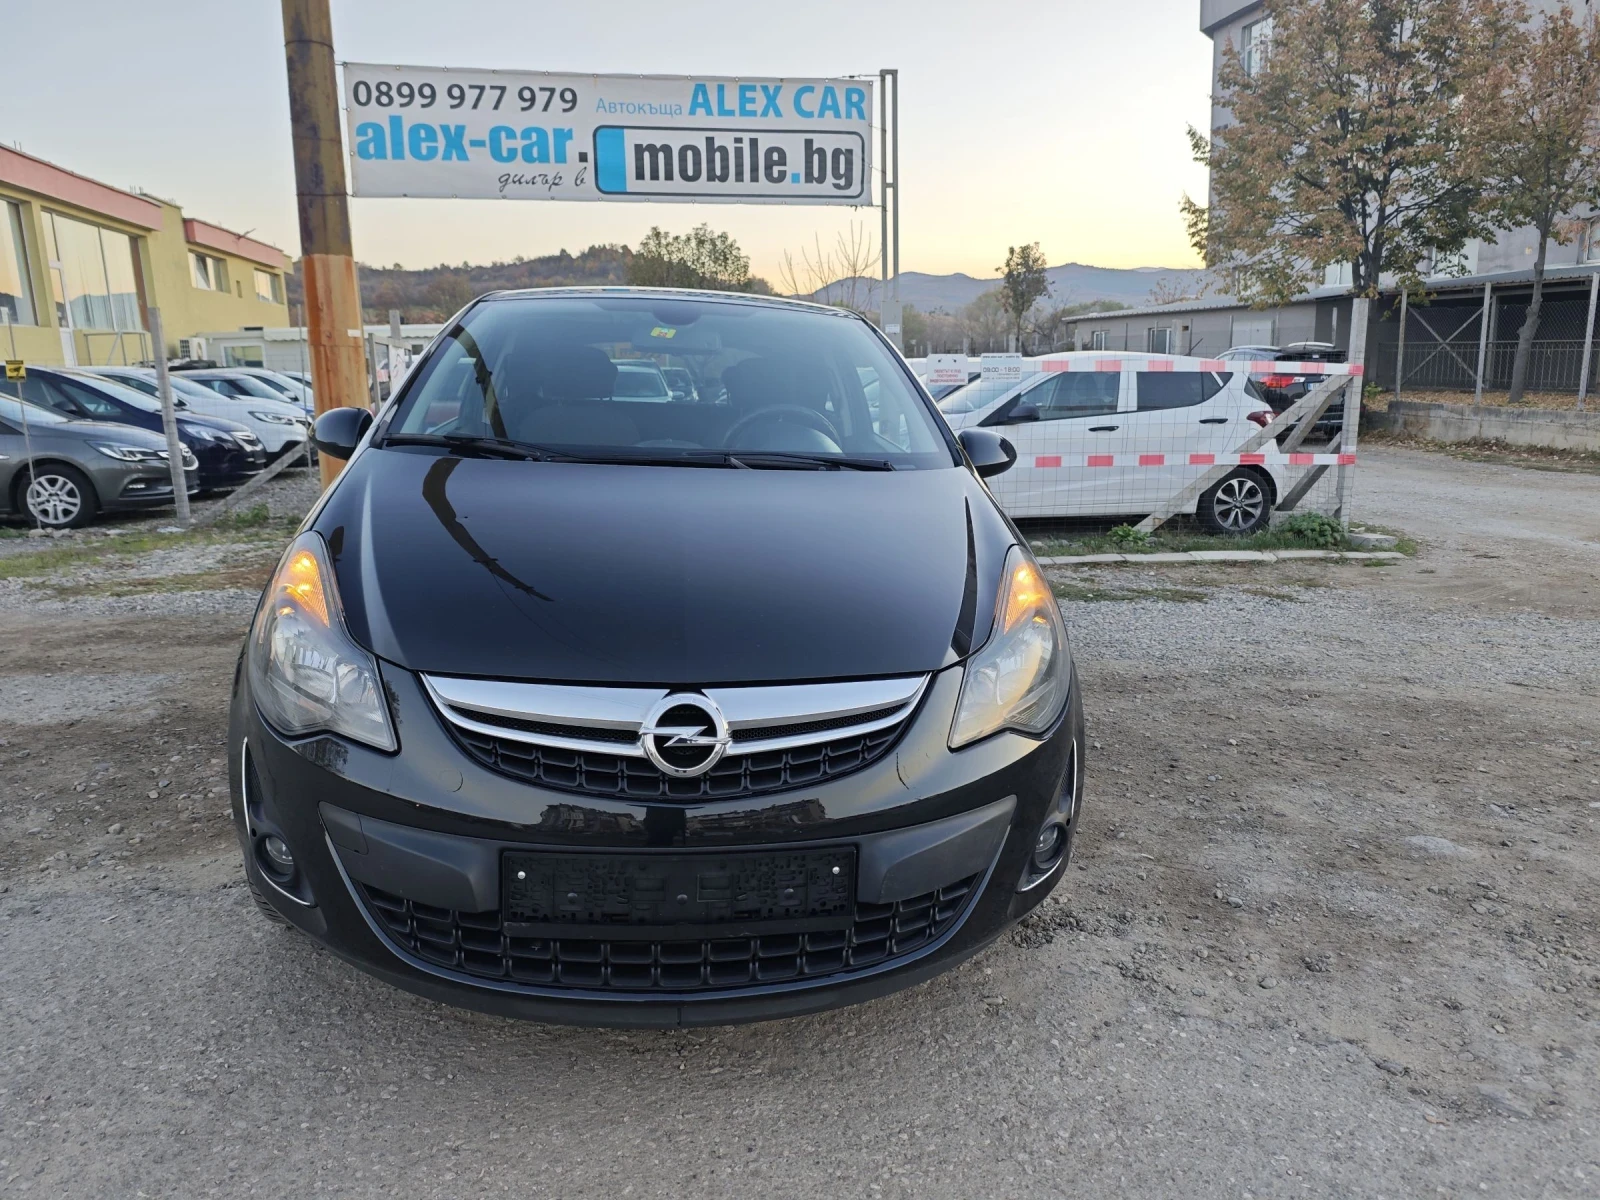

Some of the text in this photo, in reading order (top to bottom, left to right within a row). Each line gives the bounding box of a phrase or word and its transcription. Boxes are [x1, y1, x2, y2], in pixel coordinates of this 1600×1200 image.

[353, 80, 578, 113] 0899 977 979
[596, 97, 683, 118] Автокъща
[688, 83, 867, 121] ALEX CAR
[498, 166, 588, 193] дилър в
[634, 136, 854, 191] mobile.bg
